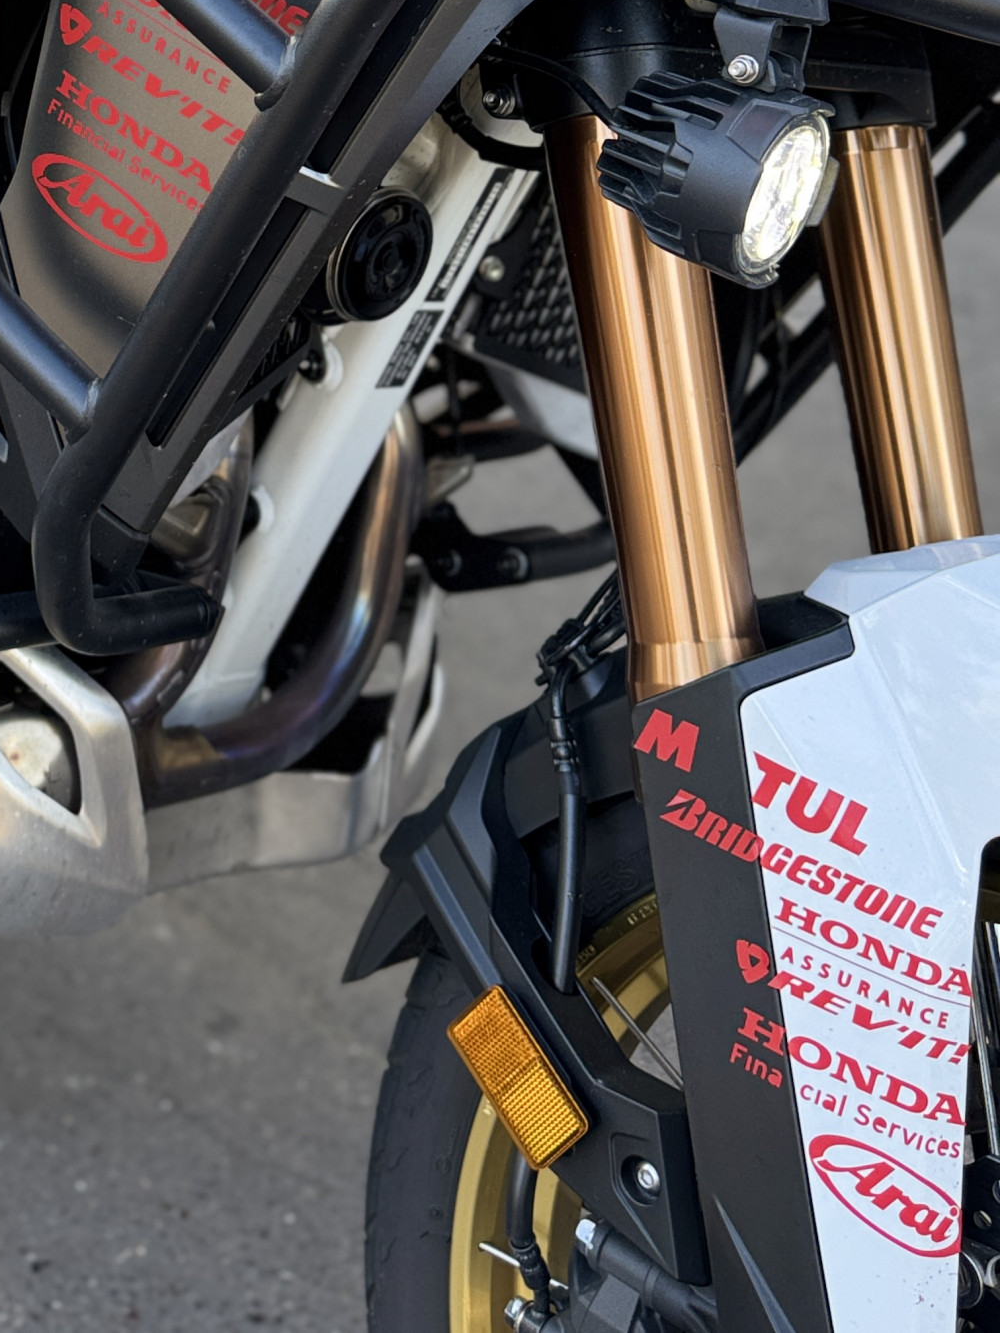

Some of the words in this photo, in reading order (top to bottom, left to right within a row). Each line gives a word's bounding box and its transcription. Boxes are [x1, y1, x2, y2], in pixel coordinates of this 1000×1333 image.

[96, 0, 232, 95] ASSURANCE
[47, 97, 127, 164] Financial
[55, 70, 213, 193] HONDA
[40, 171, 155, 250] Arai
[659, 788, 944, 940] BRIDGESTONE
[774, 896, 974, 998] HONDA
[780, 946, 949, 1030] ASSURANCE
[736, 1006, 967, 1127] HONDA
[853, 1103, 962, 1159] Services
[817, 1159, 960, 1244] Arai
